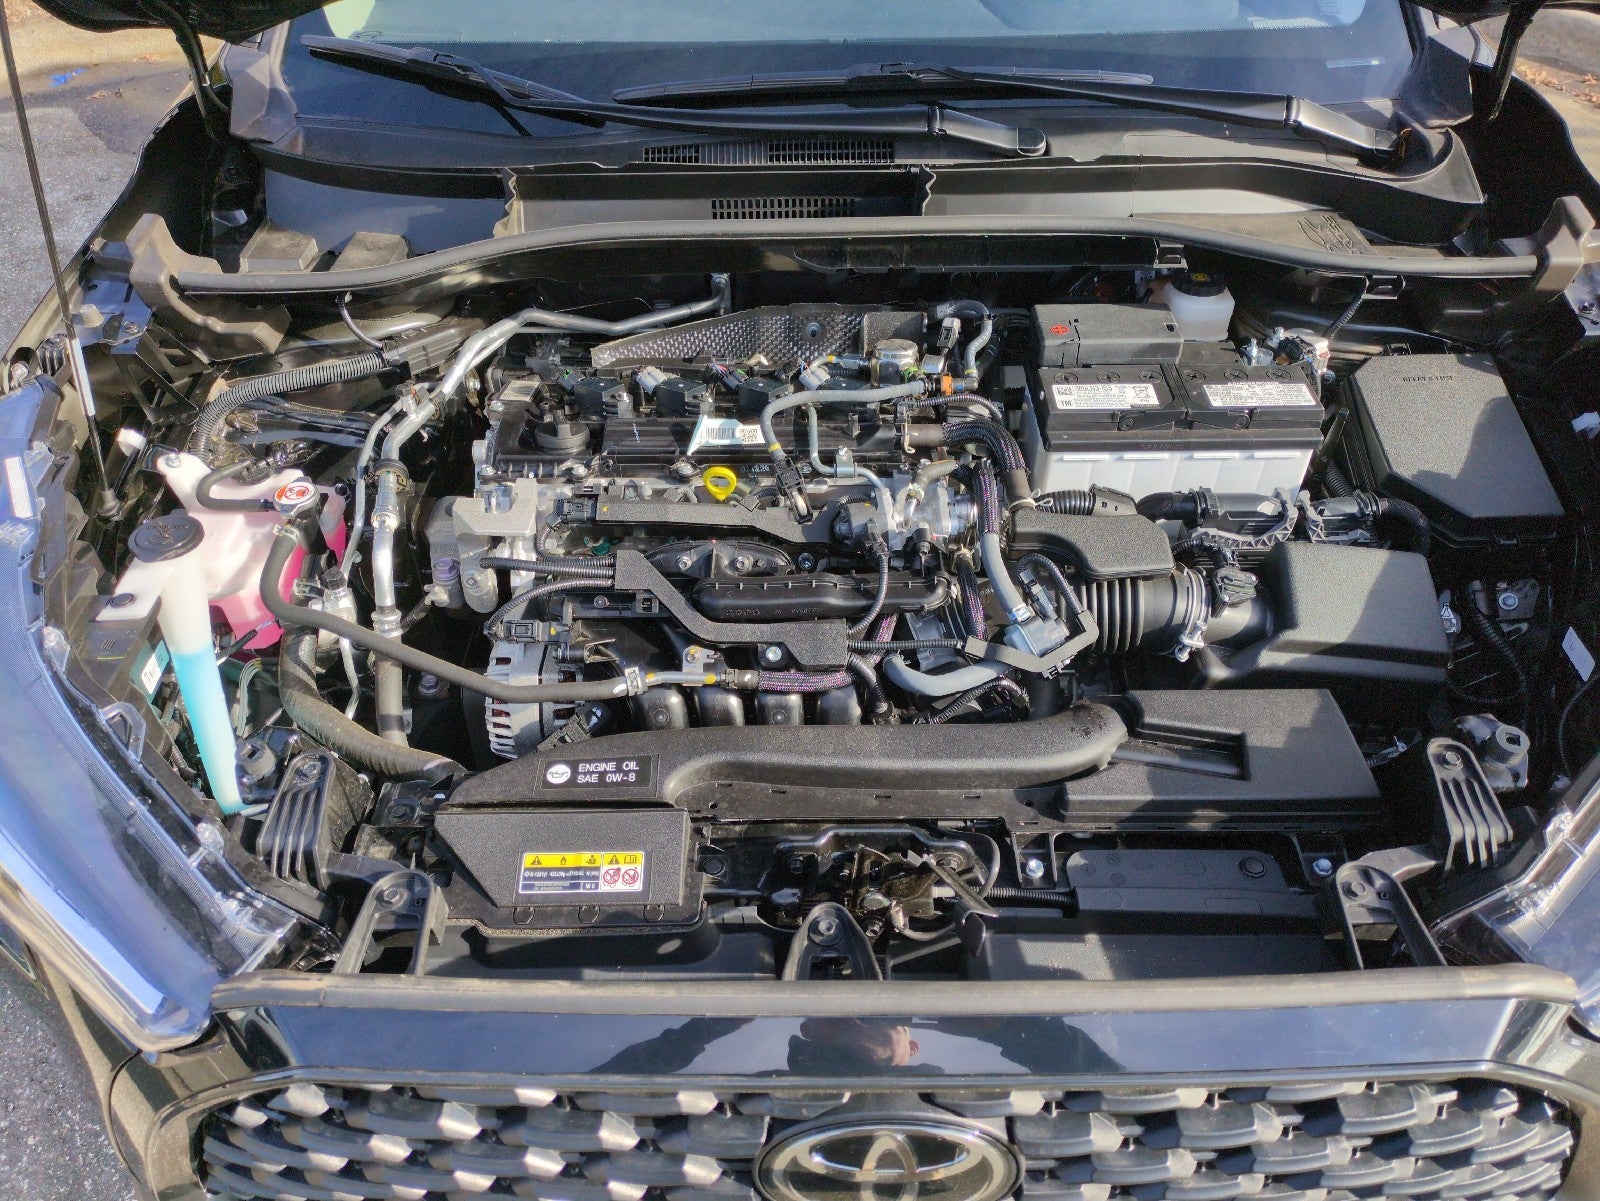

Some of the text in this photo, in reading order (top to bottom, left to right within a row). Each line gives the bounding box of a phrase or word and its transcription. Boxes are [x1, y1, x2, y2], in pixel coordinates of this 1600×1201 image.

[578, 761, 640, 773] ENGINE OIL
[577, 772, 636, 784] SAE 0W-8
